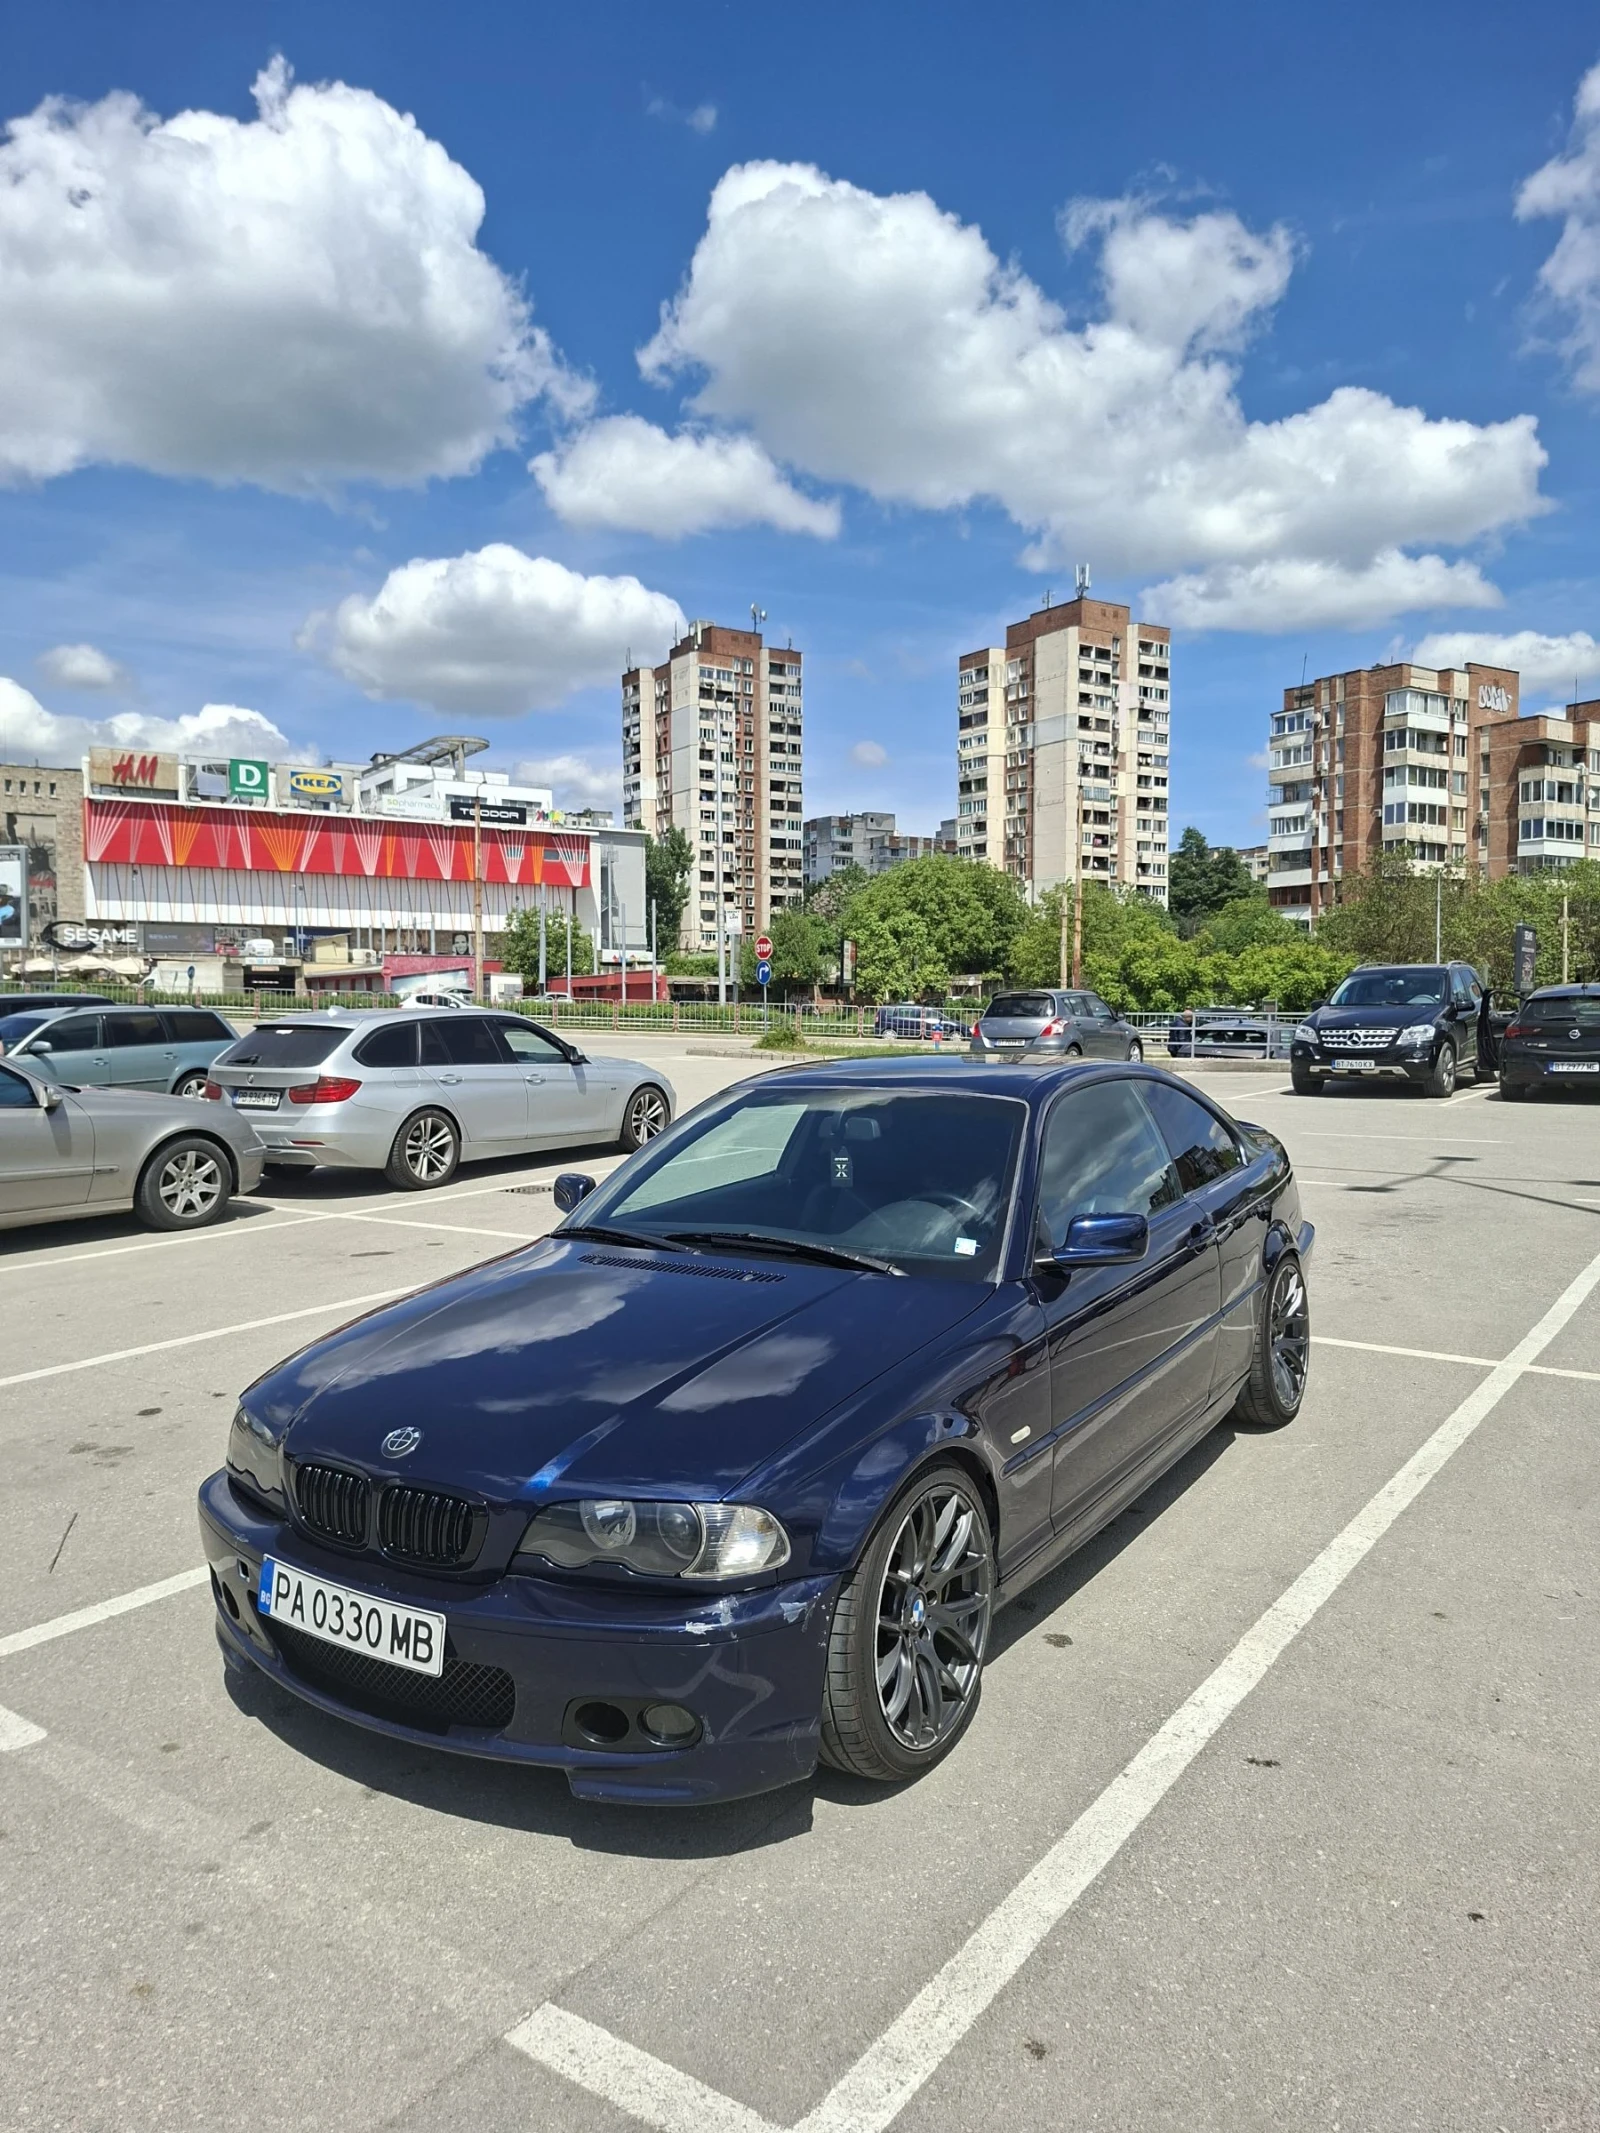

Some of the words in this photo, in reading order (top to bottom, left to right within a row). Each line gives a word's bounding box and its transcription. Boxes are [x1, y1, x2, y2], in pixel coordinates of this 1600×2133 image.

[239, 764, 261, 786] D
[295, 777, 338, 789] IKEA
[64, 927, 137, 943] SESAME
[757, 944, 771, 953] STOP
[1336, 1060, 1344, 1068] BT
[1554, 1063, 1565, 1071] BT
[1566, 1063, 1586, 1071] 2977
[260, 1590, 271, 1605] BG
[274, 1570, 305, 1623] PA
[312, 1588, 383, 1649] 0330
[389, 1613, 434, 1664] MB
